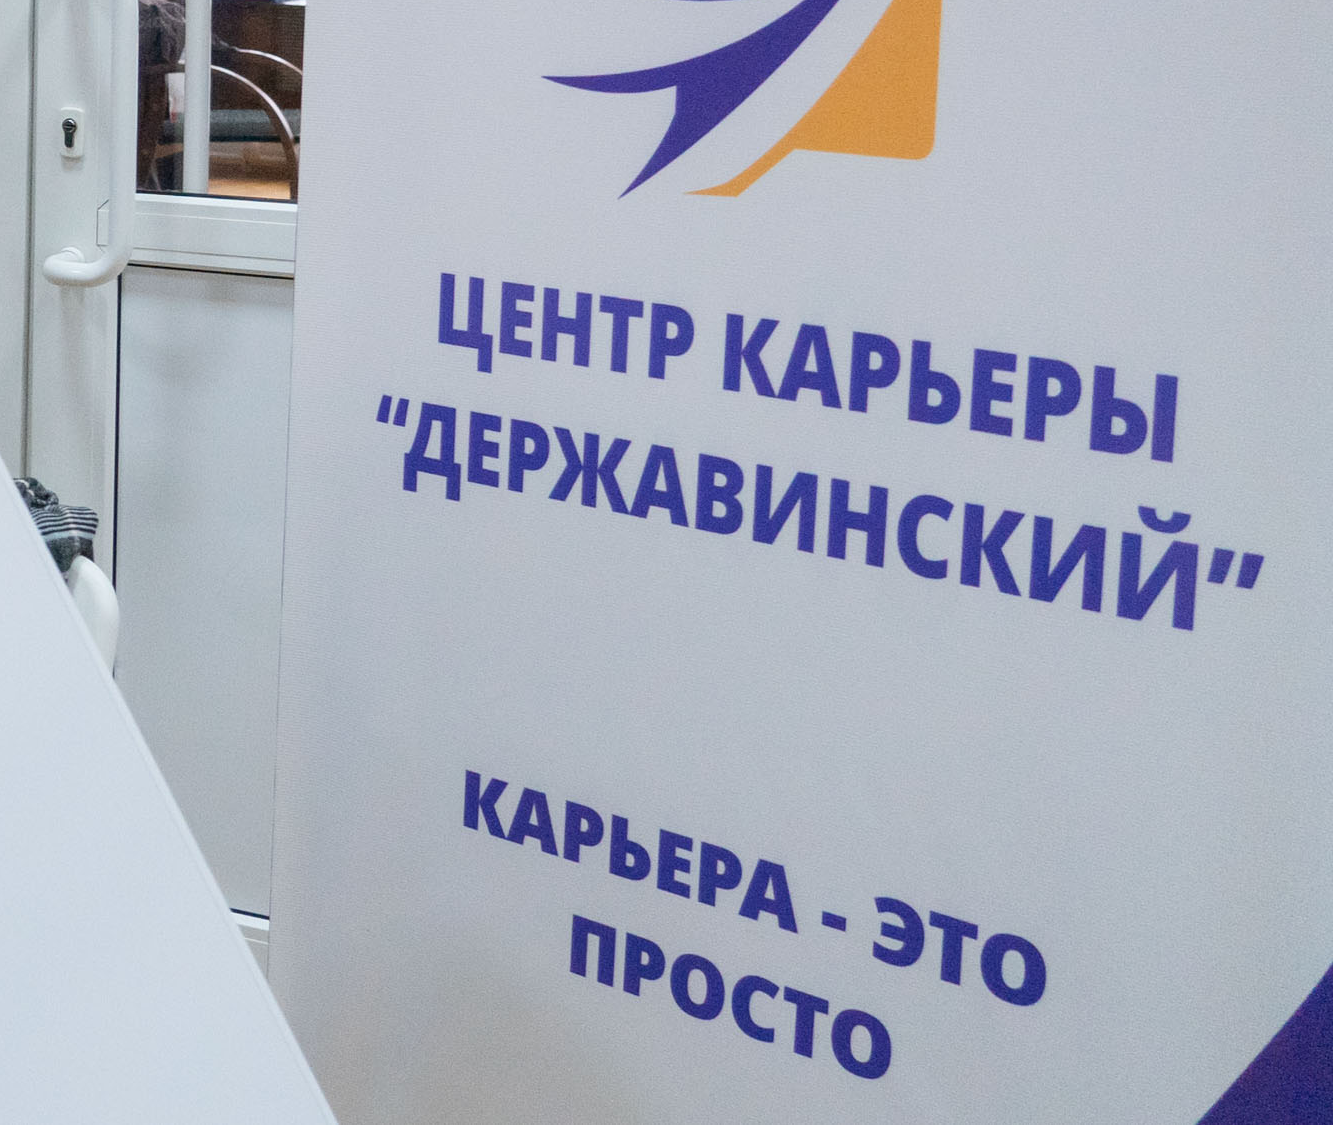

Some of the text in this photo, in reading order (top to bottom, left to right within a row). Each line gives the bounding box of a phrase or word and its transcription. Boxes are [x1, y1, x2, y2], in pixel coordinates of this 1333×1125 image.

[437, 273, 1179, 463] ЦЕНТР КАРЬЕРЫ
[463, 769, 799, 934] КАРЬЕРА
[872, 896, 1047, 1007] ЭТО
[569, 914, 892, 1080] ПРОСТО
